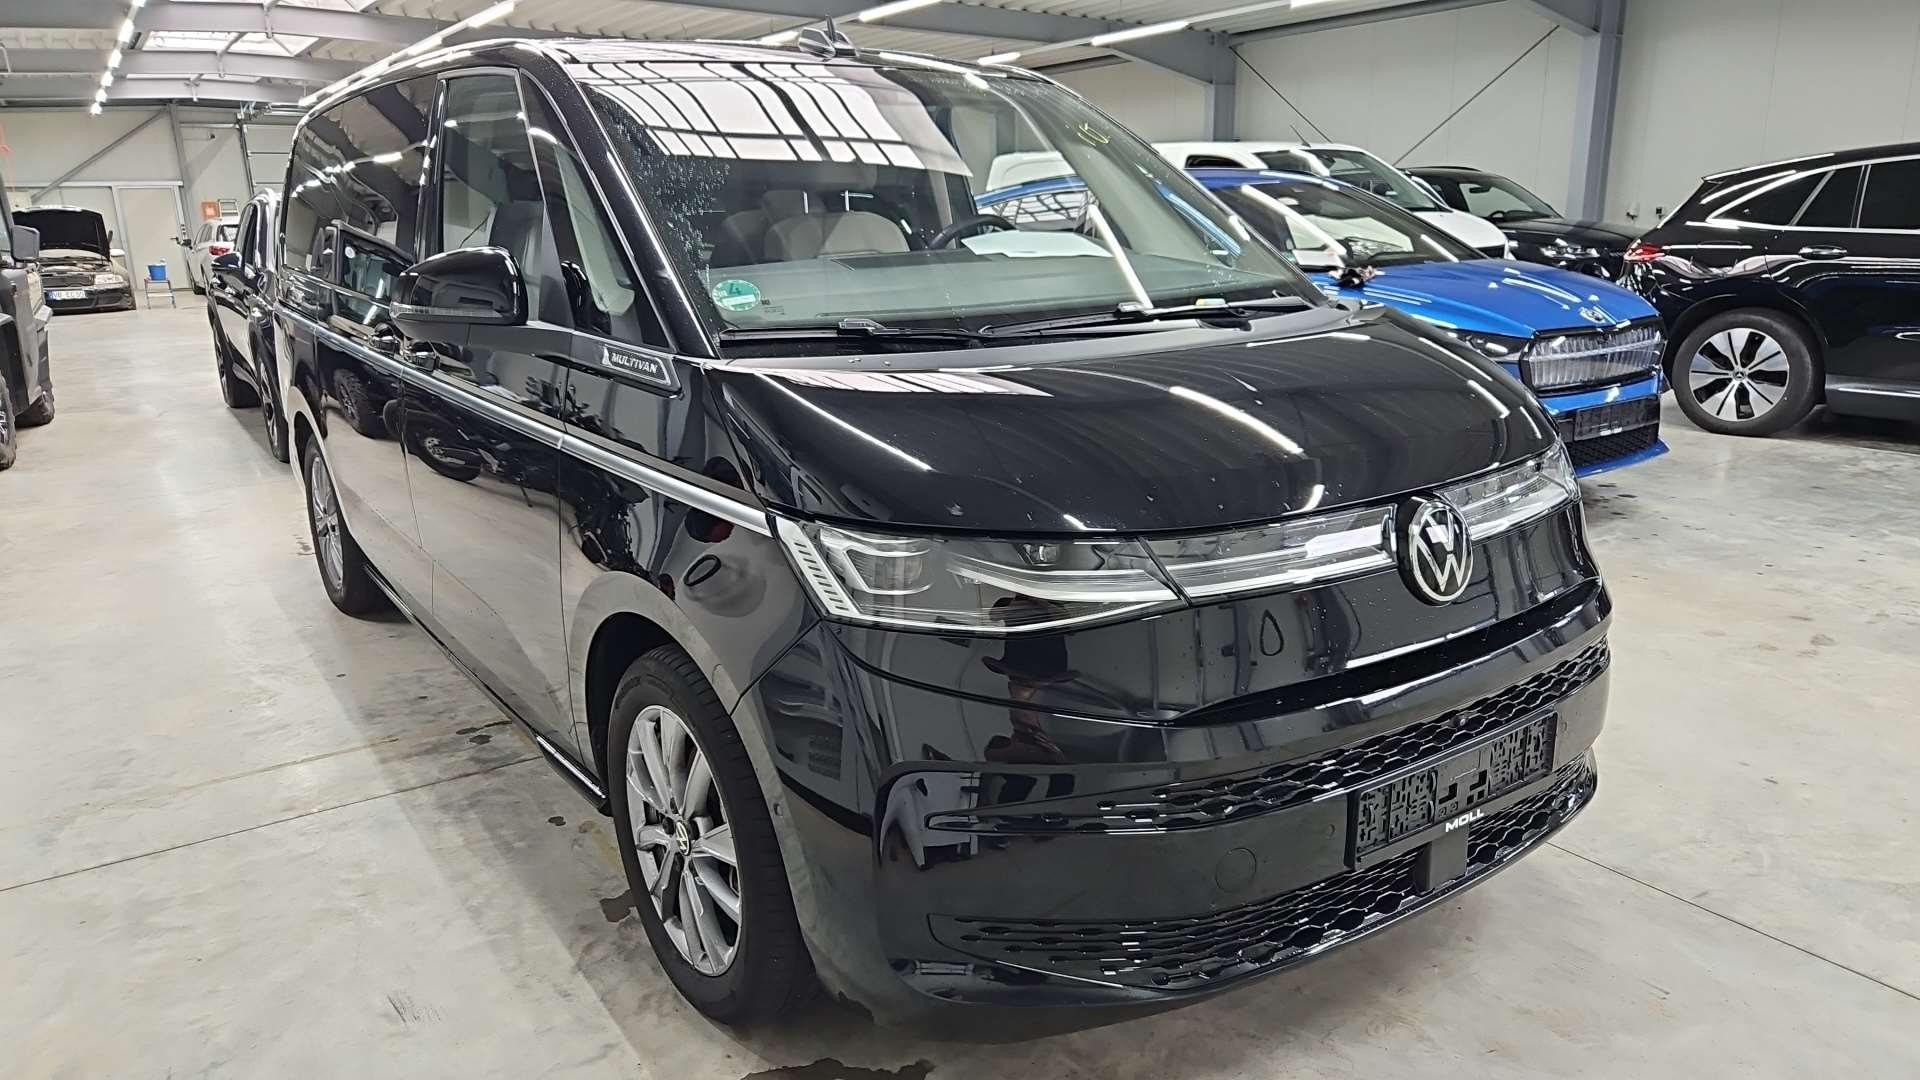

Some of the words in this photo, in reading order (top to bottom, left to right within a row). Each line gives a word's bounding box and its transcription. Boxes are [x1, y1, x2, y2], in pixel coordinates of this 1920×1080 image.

[729, 283, 742, 295] 4
[611, 352, 658, 374] MULTIVAN
[1445, 808, 1485, 833] MOLL
